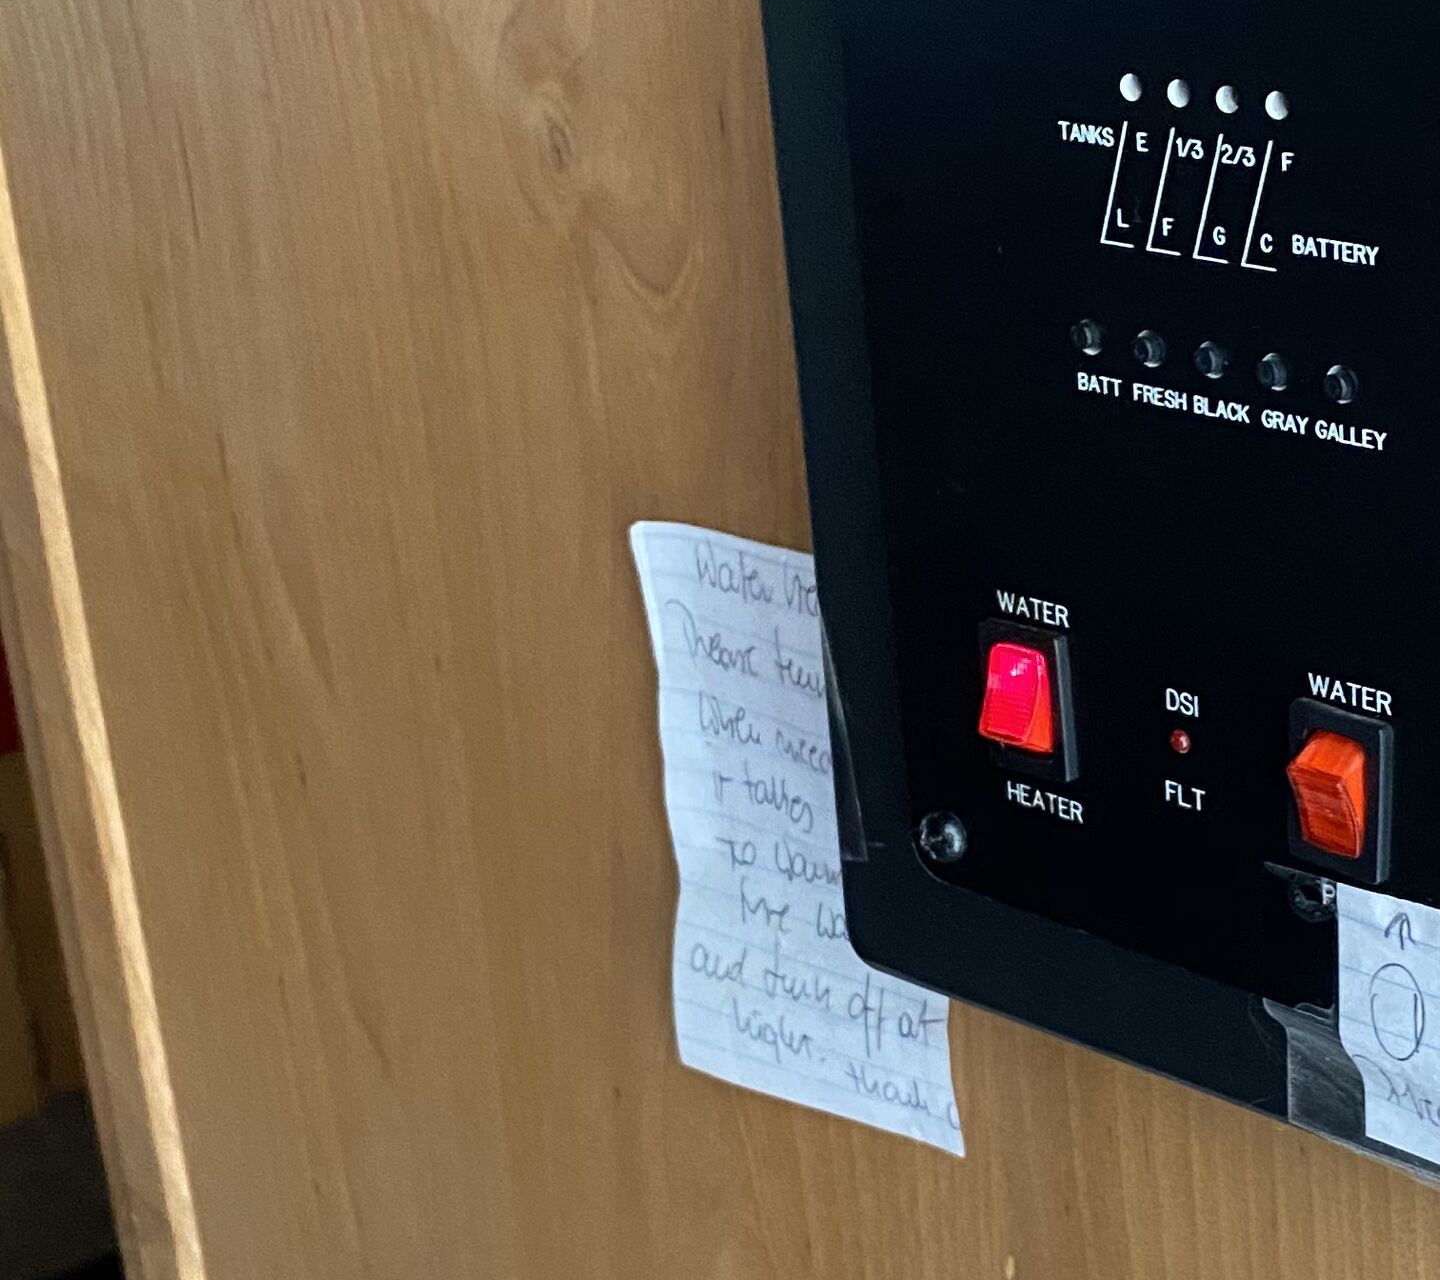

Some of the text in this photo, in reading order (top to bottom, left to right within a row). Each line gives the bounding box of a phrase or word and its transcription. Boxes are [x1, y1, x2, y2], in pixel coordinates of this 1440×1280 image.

[1058, 121, 1294, 171] TANKS E 1/3 2/3 F
[1117, 208, 1379, 265] L F G C BATTERY
[1078, 372, 1387, 450] BATT FRESH BLACK GRAY GALLEY
[997, 590, 1069, 628] WATER
[1166, 688, 1198, 717] DSI
[1308, 672, 1392, 717] WATER
[1008, 778, 1083, 823] HEATER
[1165, 780, 1205, 810] FLT
